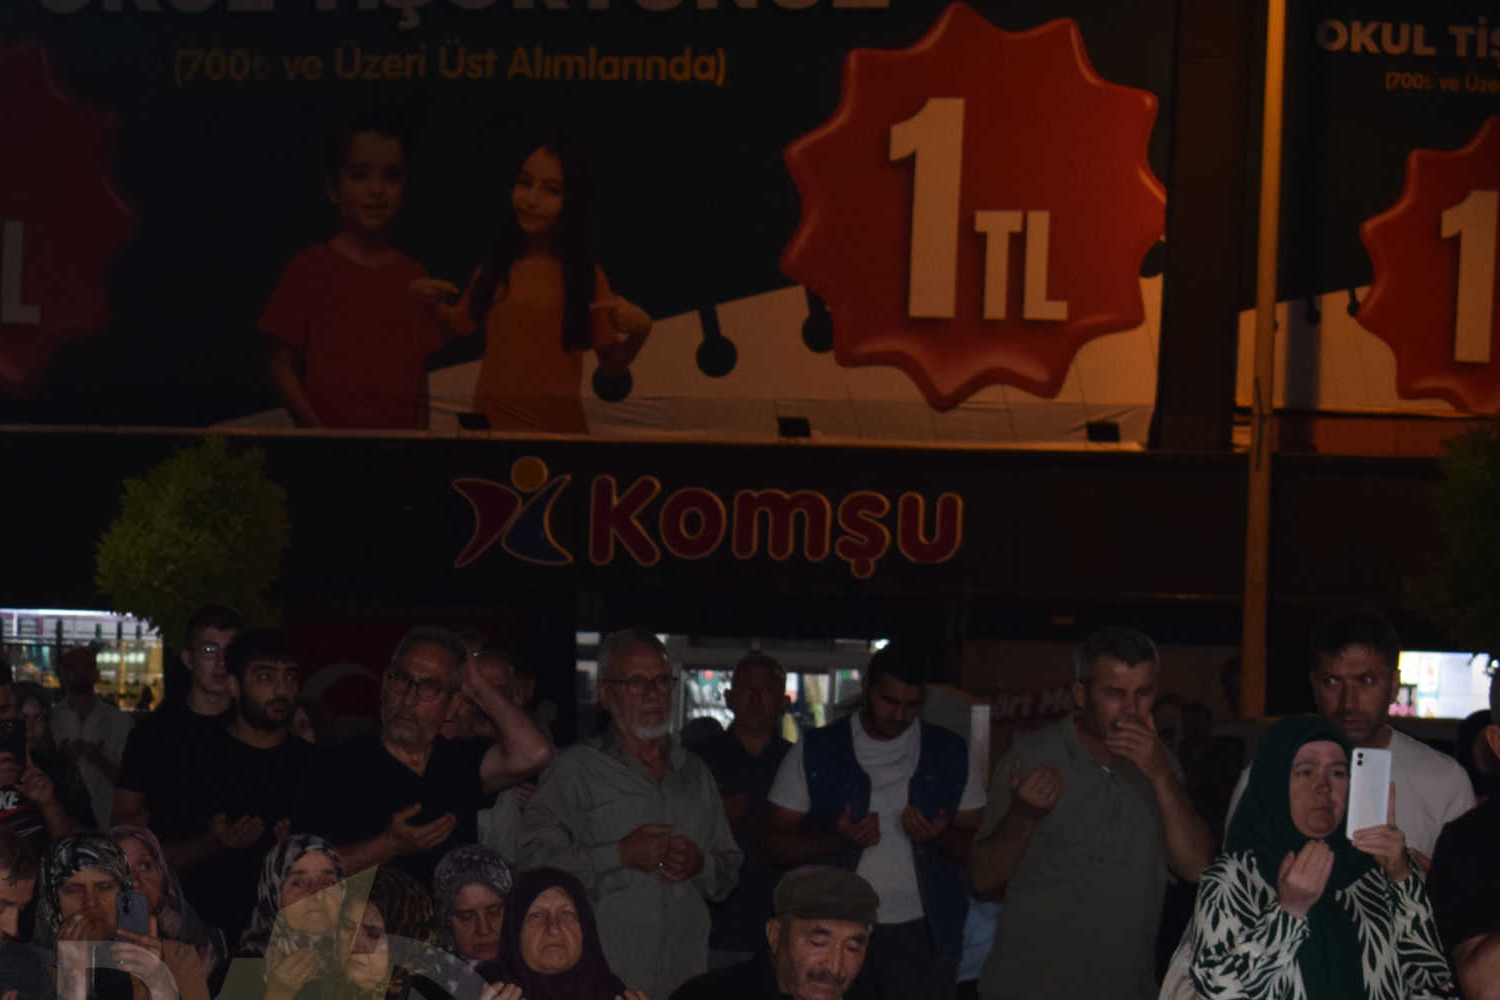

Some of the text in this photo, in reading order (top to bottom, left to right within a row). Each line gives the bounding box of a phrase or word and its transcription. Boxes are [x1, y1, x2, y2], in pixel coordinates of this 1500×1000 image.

[282, 54, 324, 81] ve
[333, 39, 428, 81] Üzeri
[438, 36, 498, 80] Üst
[506, 43, 727, 86] Alımlarında)
[1316, 18, 1437, 56] OKUL
[888, 96, 1069, 322] 1 TL
[1440, 189, 1500, 364] 1
[588, 473, 965, 580] Komşu
